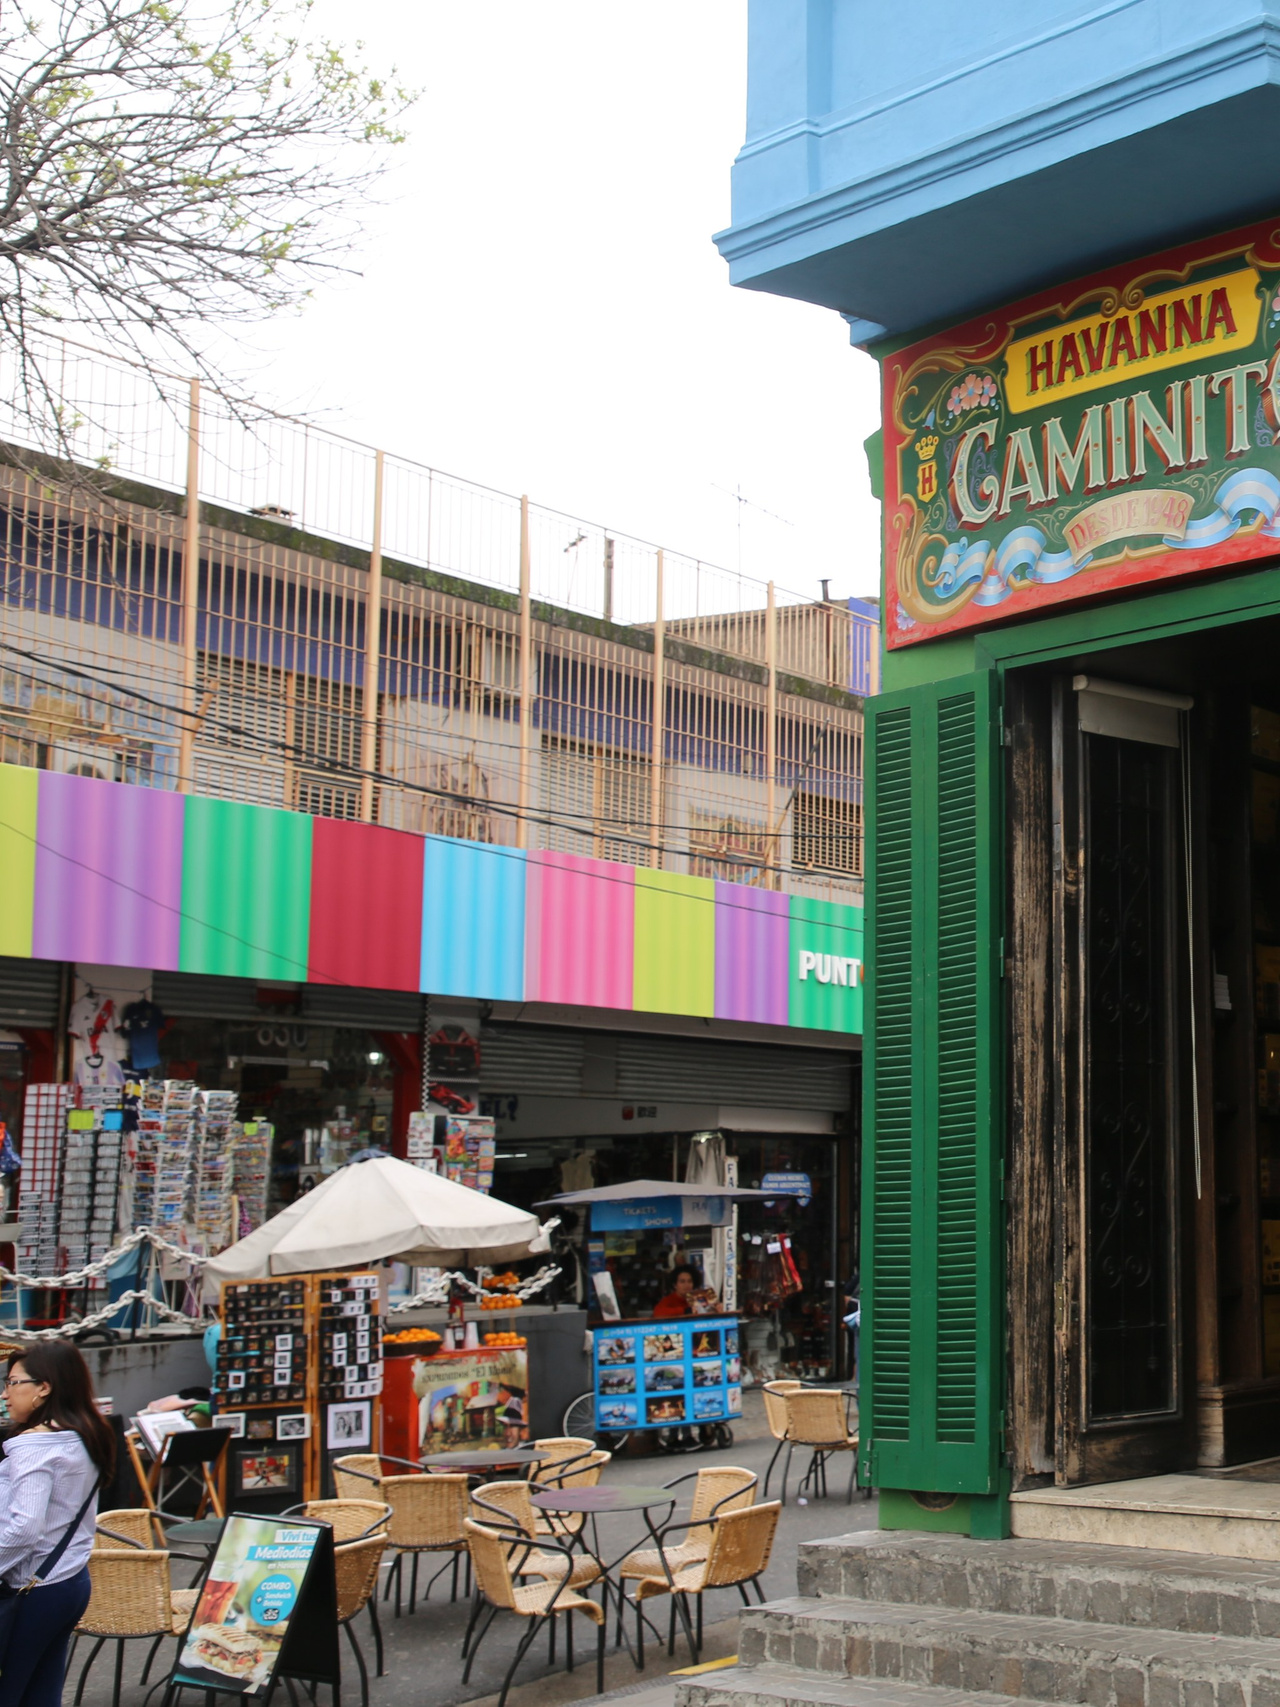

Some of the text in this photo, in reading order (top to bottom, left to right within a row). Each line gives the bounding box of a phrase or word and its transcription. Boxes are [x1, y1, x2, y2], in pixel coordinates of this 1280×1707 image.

[1026, 286, 1238, 398] HAVANNA
[1070, 489, 1187, 552] DESDE 1948
[799, 950, 865, 988] PUNT
[623, 1206, 657, 1216] TICKETS
[644, 1217, 673, 1226] SHOWS
[261, 1582, 292, 1591] COMBO
